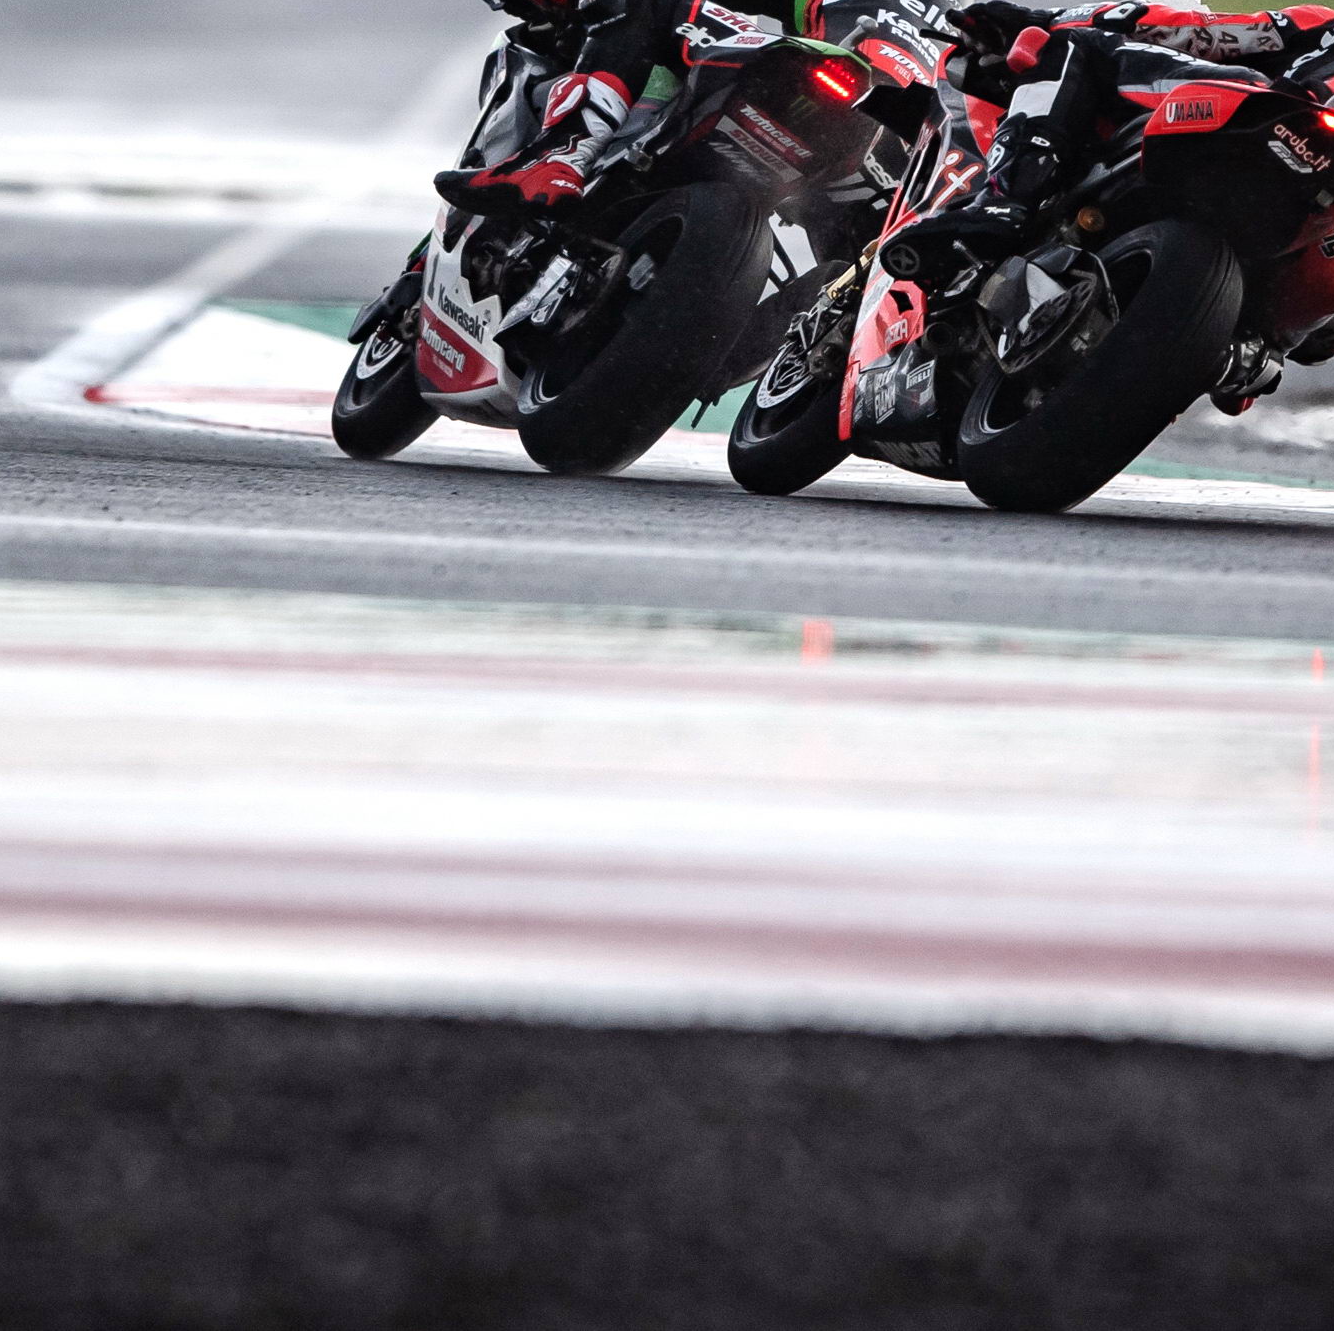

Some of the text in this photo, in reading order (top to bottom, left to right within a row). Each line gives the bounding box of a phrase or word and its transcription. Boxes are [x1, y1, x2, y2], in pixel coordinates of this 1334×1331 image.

[734, 35, 766, 45] SHOWA
[891, 26, 935, 68] Racing
[739, 103, 813, 159] Motocard
[1166, 101, 1215, 124] UMANA
[728, 129, 788, 170] SHOWA
[1273, 123, 1331, 172] aruba.it
[438, 283, 484, 344] Kawasaki
[422, 316, 465, 373] Motocard
